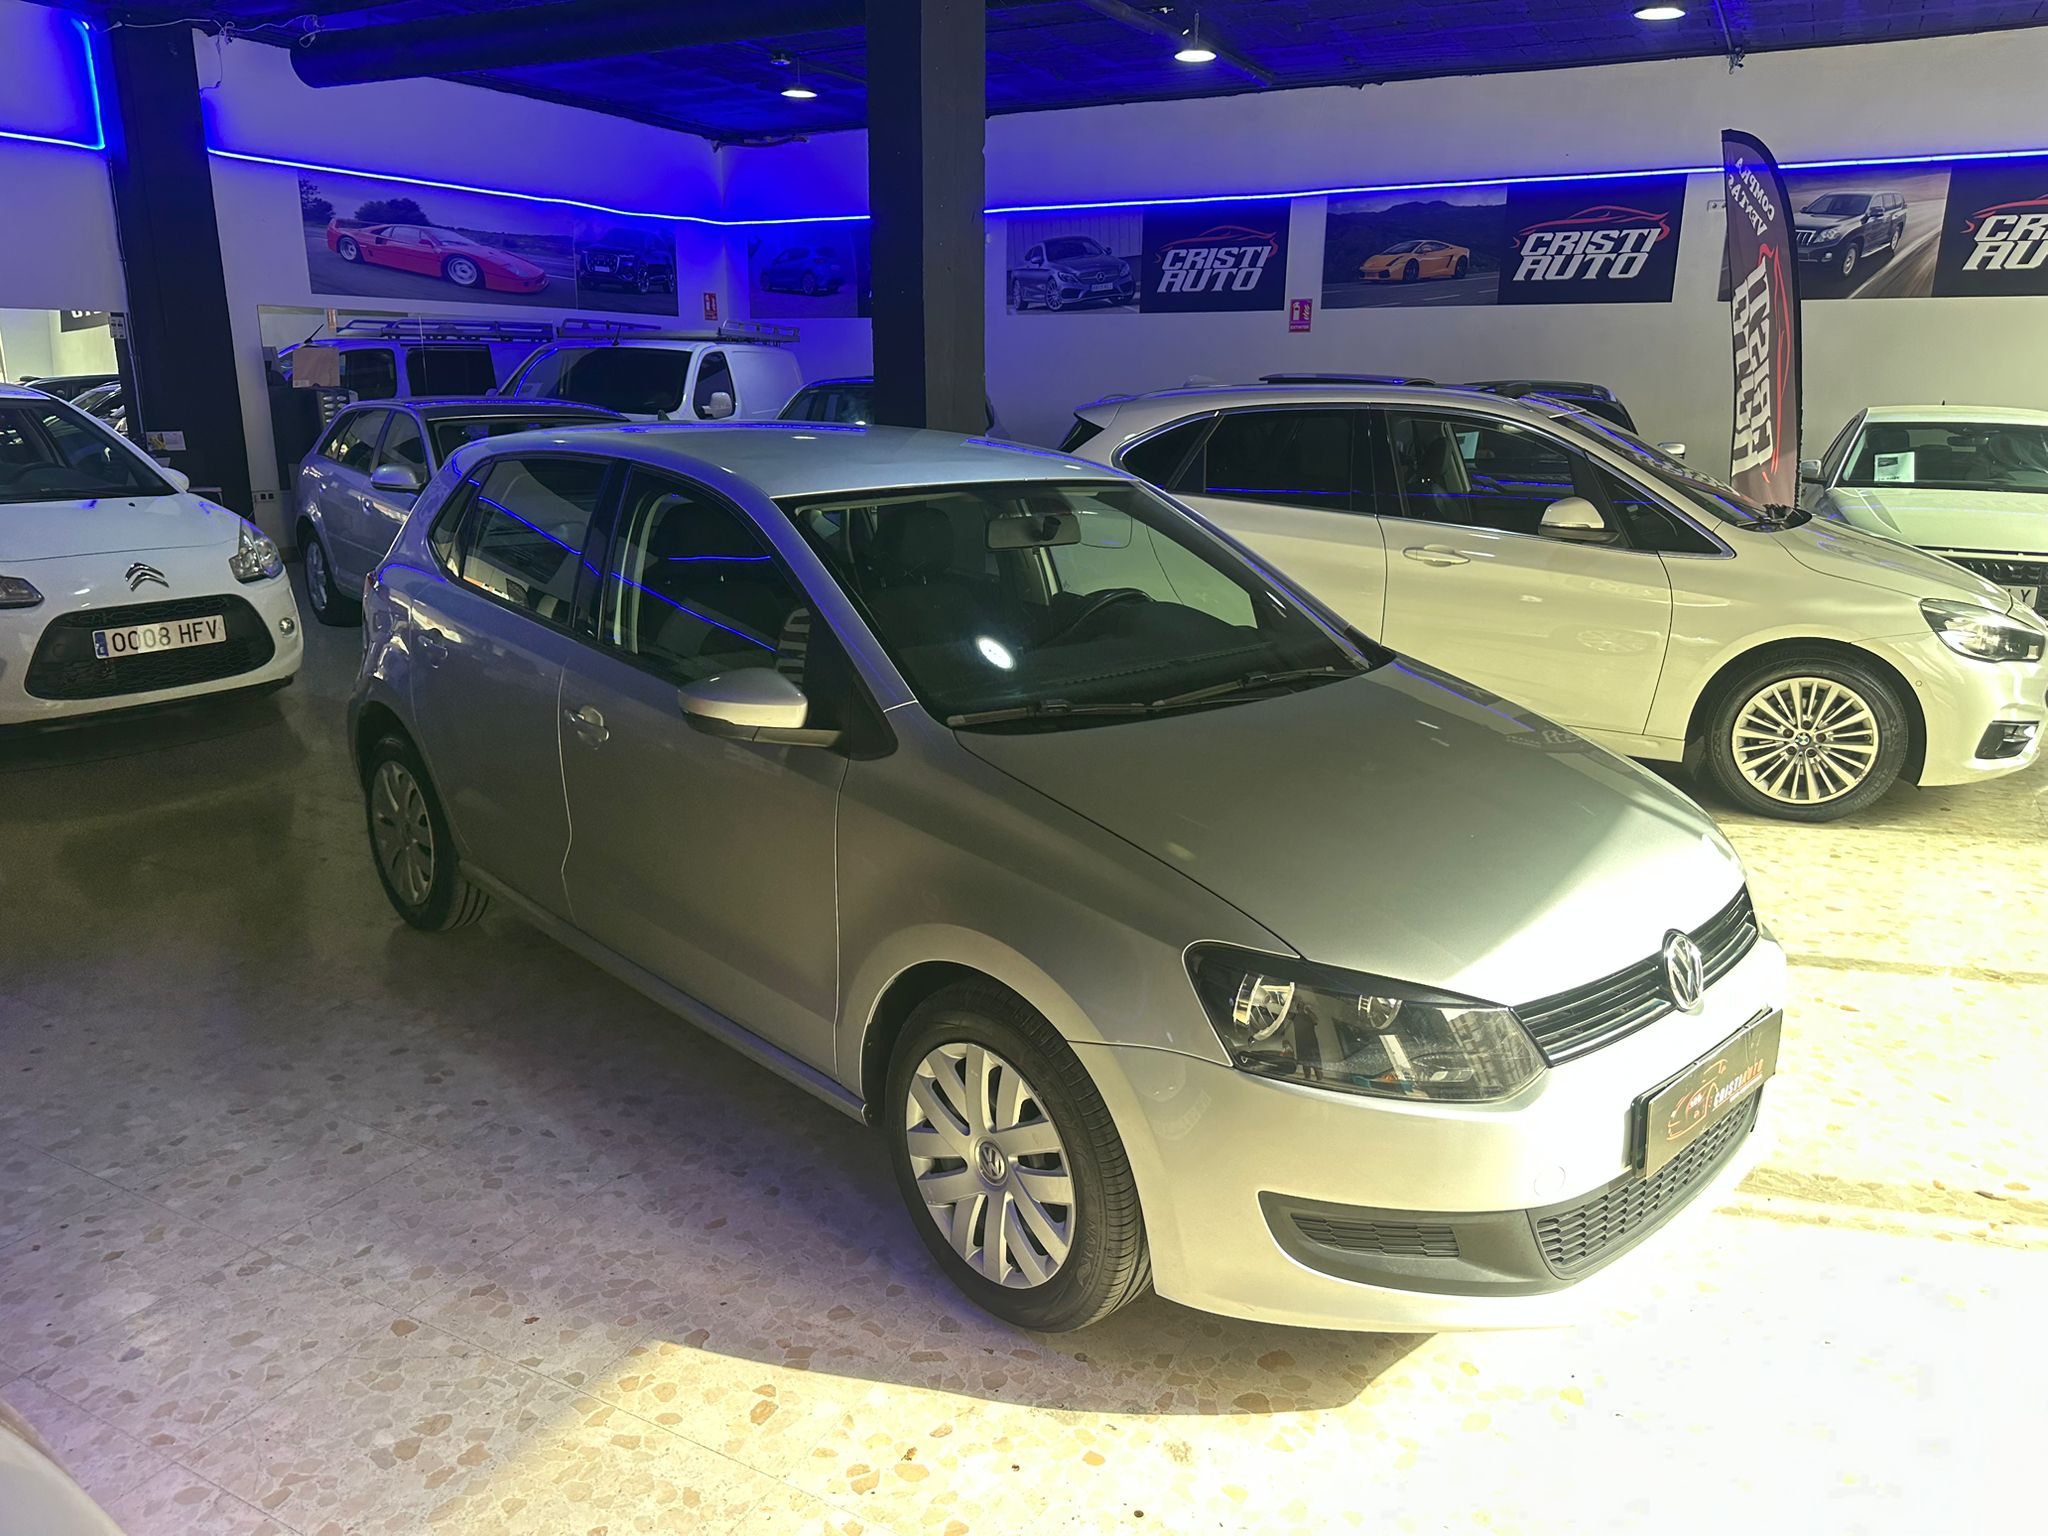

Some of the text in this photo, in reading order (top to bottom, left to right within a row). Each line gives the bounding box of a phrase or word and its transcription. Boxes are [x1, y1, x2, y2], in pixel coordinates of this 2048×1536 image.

[1520, 227, 1661, 256] CRISTI
[1973, 213, 2048, 242] CR
[1161, 246, 1273, 270] CRISTI
[1512, 252, 1649, 281] AUTO
[1156, 267, 1263, 293] AUTO
[111, 619, 217, 652] 0008 HFV
